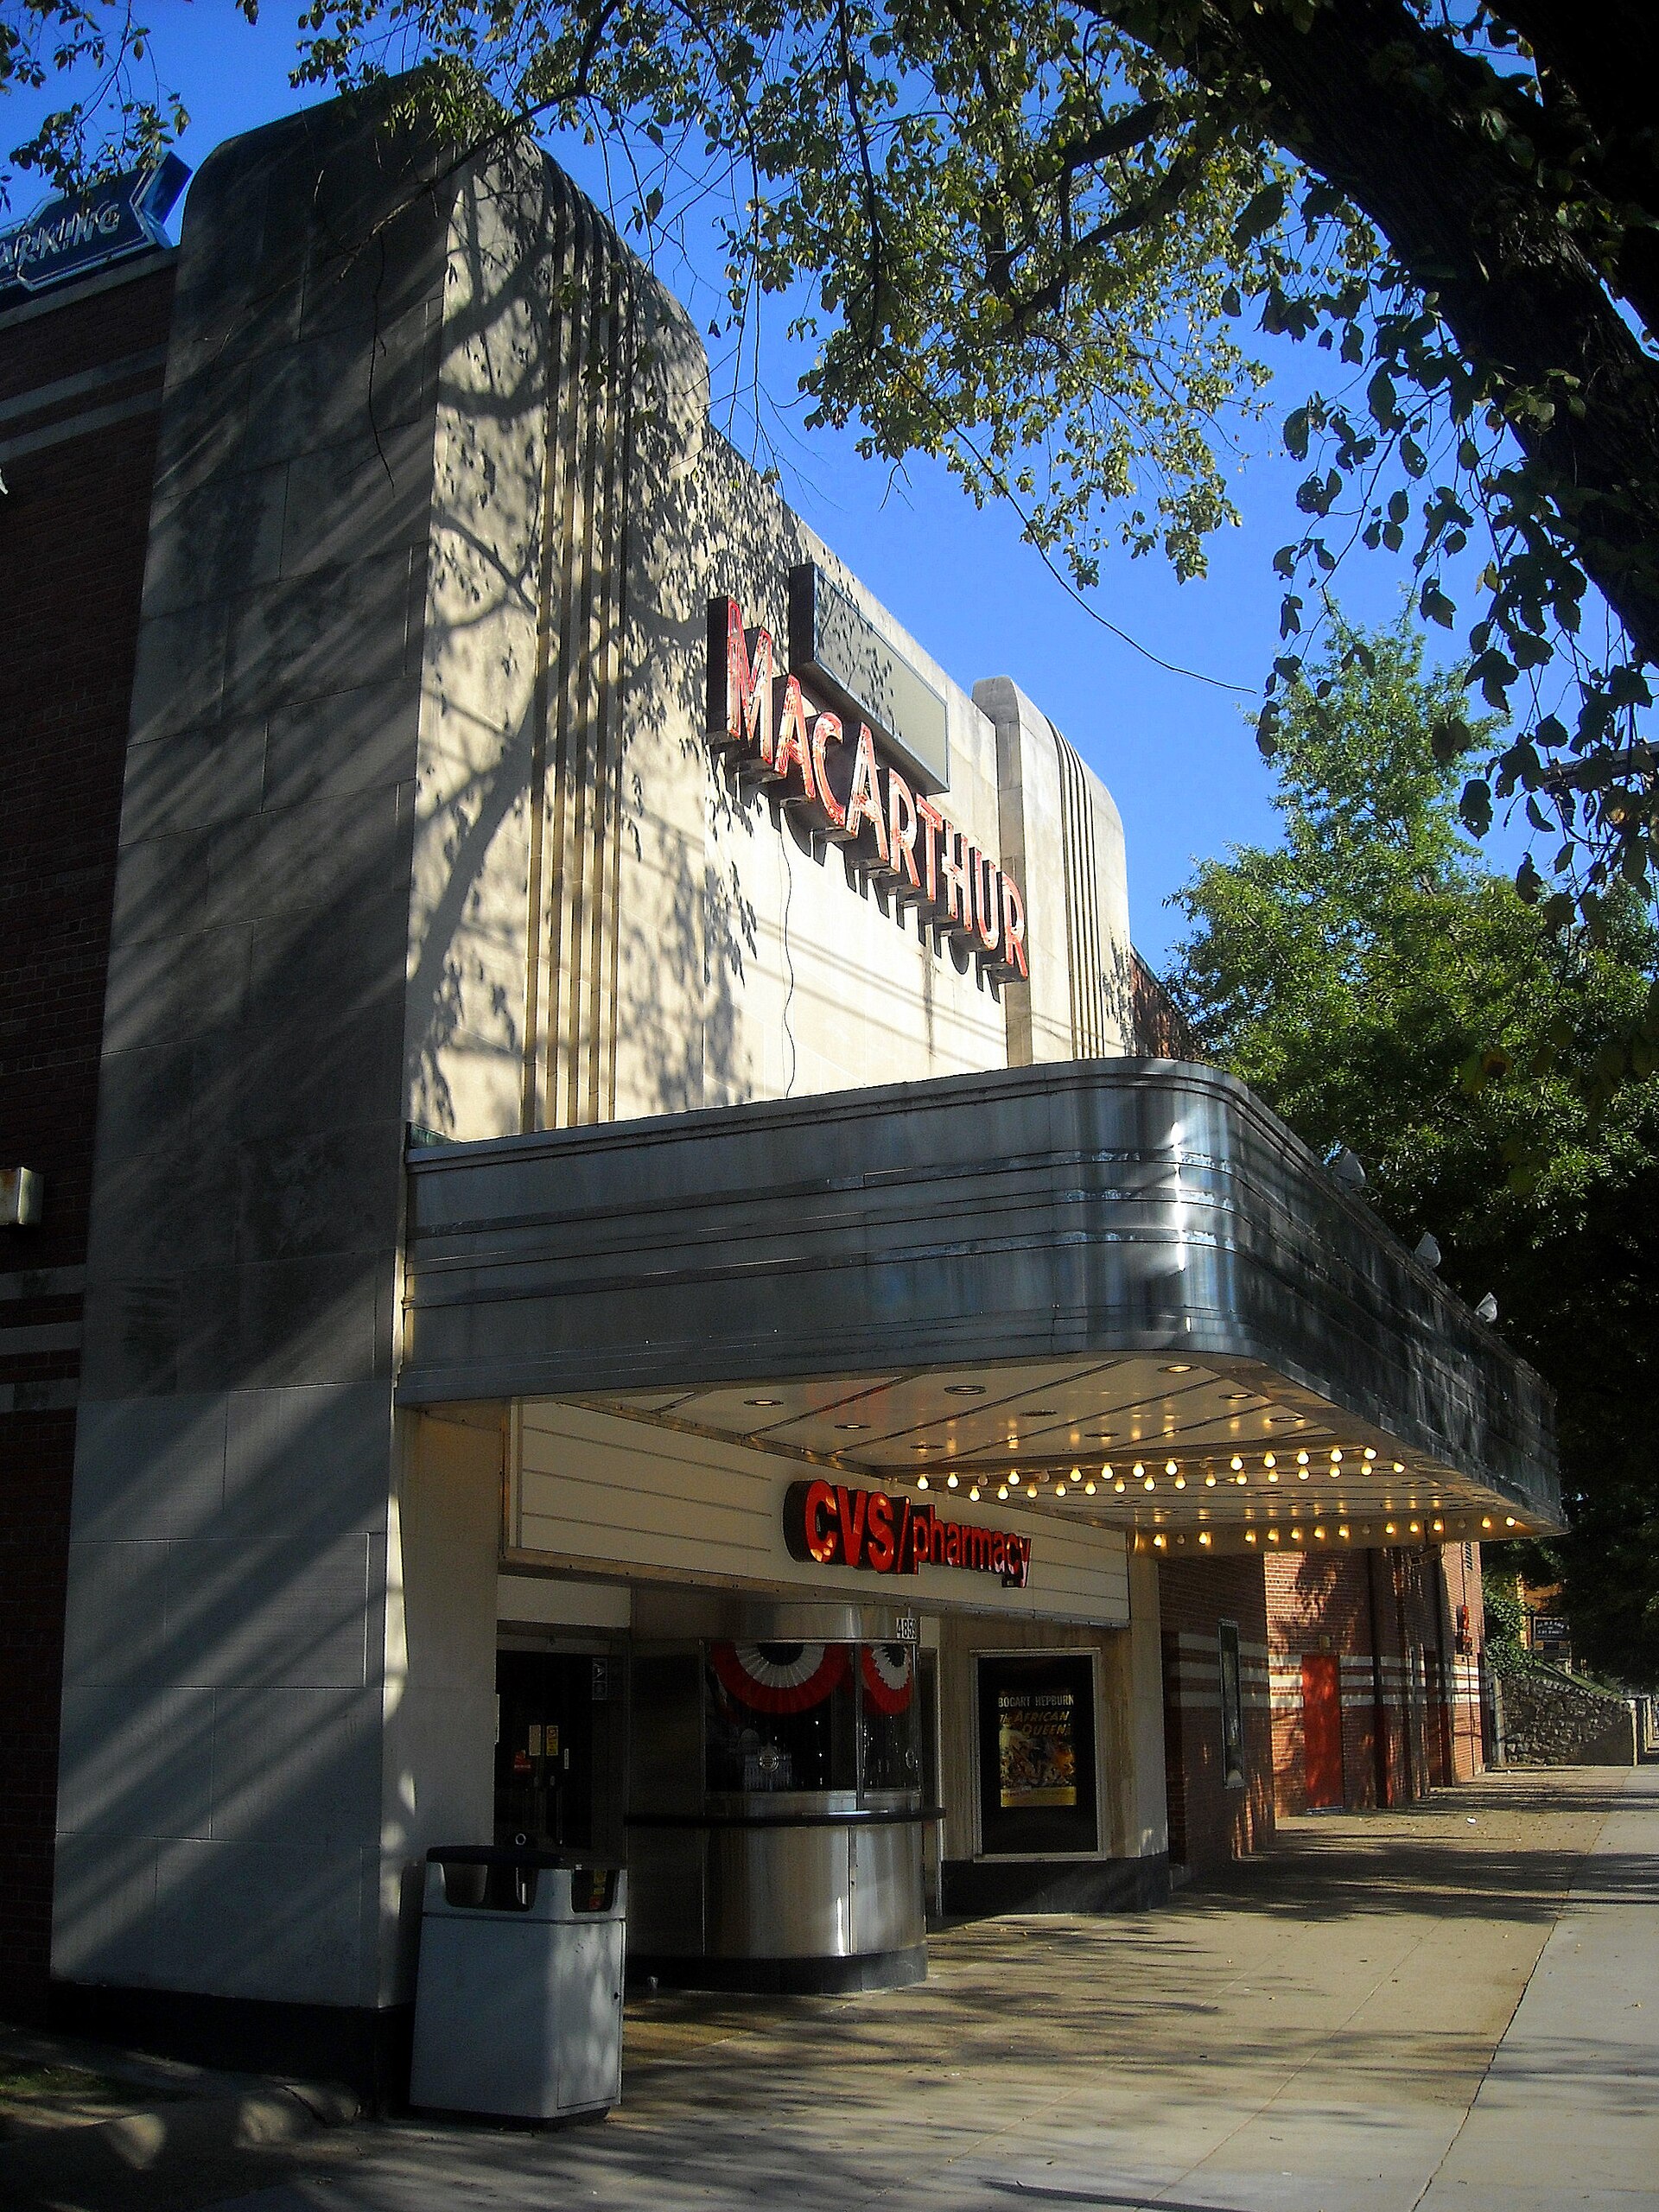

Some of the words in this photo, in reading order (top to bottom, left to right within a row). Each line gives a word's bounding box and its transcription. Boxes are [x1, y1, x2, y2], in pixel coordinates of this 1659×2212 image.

[726, 594, 1029, 980] MACARTHUR
[804, 1478, 1032, 1588] CVS/pharmacy
[998, 1695, 1031, 1707] BOGART
[1034, 1694, 1075, 1707] HEPBURN
